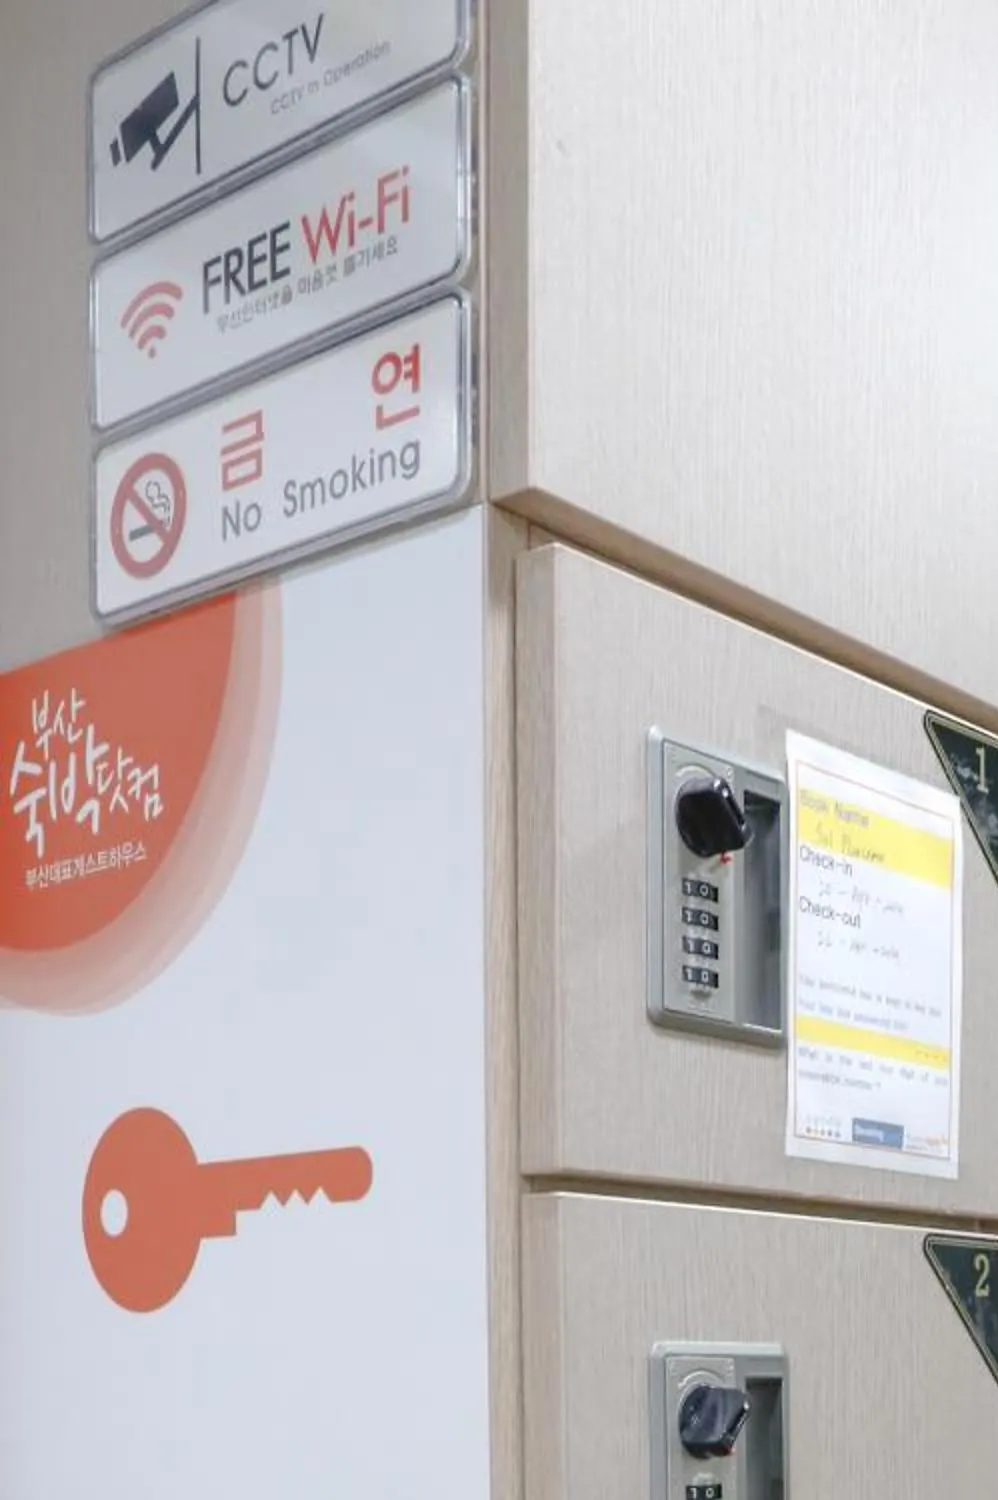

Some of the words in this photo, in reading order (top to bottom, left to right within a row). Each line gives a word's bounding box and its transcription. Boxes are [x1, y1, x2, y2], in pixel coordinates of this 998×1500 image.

[222, 13, 324, 107] CCTV
[270, 82, 304, 115] CCTV
[322, 41, 392, 87] Operation
[202, 221, 291, 315] FREE
[301, 166, 411, 266] Wi-Fi
[220, 410, 265, 492] 금
[371, 343, 421, 430] 연
[221, 502, 263, 542] No
[283, 437, 422, 520] Smoking
[31, 687, 88, 761] 부산
[975, 747, 989, 794] 1
[799, 844, 854, 876] Check-in
[799, 895, 861, 930] Check-out
[974, 1253, 991, 1298] 2
